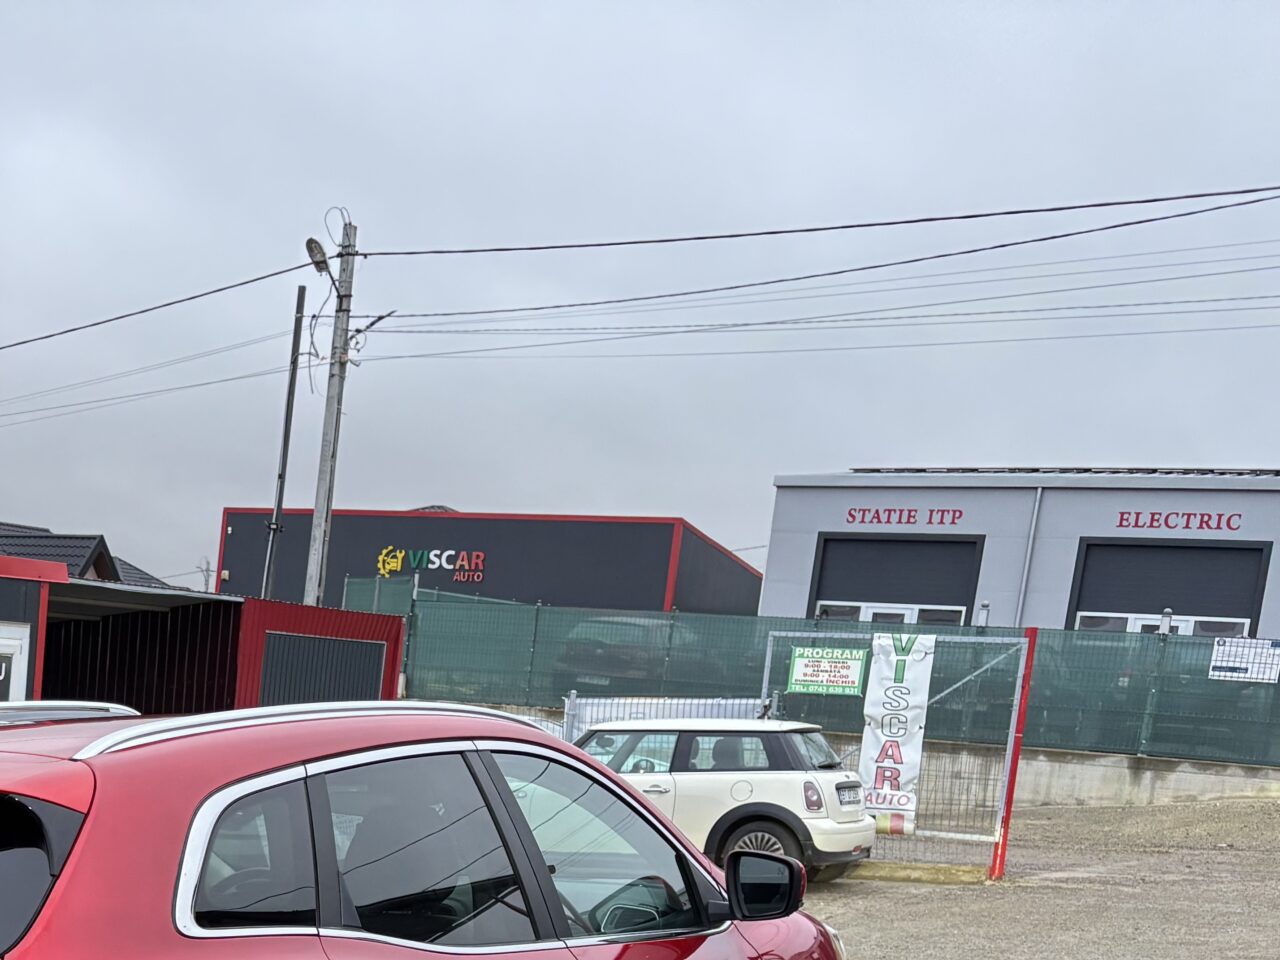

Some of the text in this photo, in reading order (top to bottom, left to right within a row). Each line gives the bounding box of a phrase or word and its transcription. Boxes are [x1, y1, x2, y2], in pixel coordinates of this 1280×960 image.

[846, 507, 964, 525] STATIE ITP
[1115, 511, 1242, 531] ELECTRIC
[408, 549, 485, 570] VISCAR
[452, 571, 483, 582] AUTO
[795, 647, 864, 660] PROGRAM
[873, 633, 919, 792] VISCAR
[864, 791, 911, 807] AUTO
